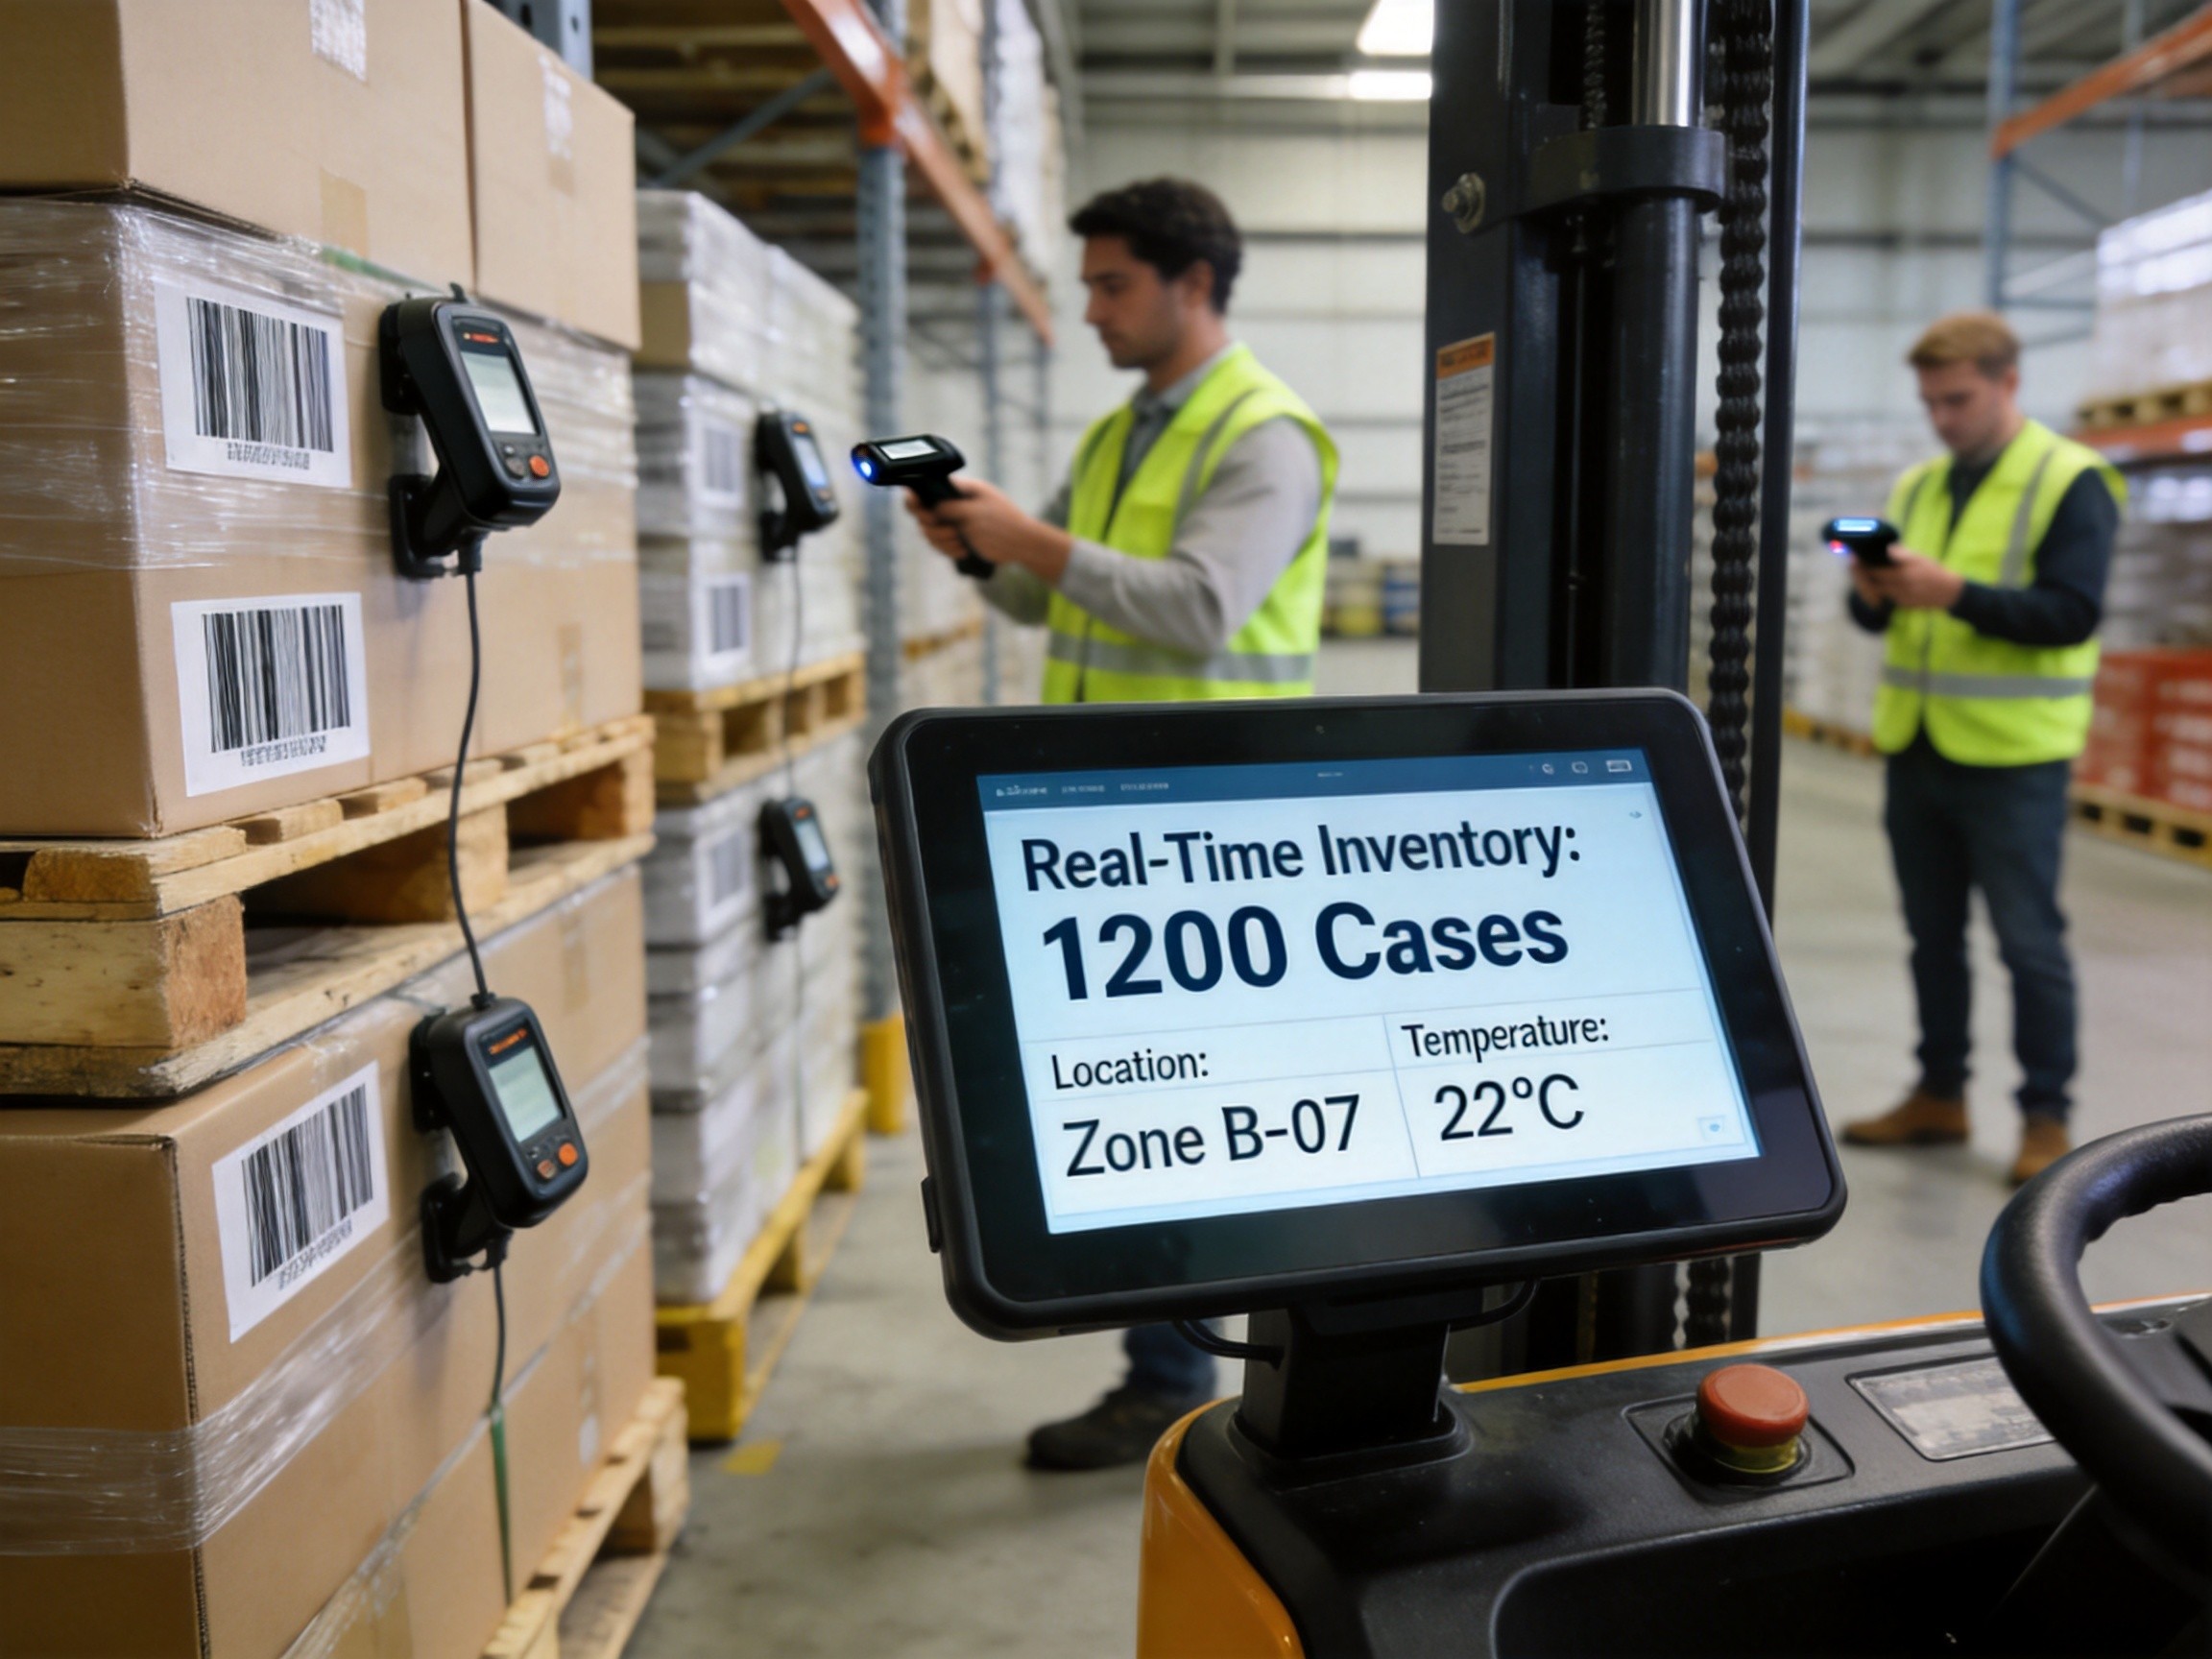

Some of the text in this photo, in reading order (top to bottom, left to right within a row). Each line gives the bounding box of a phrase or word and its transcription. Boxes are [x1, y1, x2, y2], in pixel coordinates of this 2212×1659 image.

[1021, 821, 1581, 893] Real-Time Inventory:
[1043, 902, 1570, 1000] 1200 Cases
[1051, 1048, 1210, 1091] Location:
[1401, 1014, 1610, 1063] Temperature:
[1063, 1093, 1360, 1177] Zone B-07
[1434, 1072, 1585, 1142] 22°C
